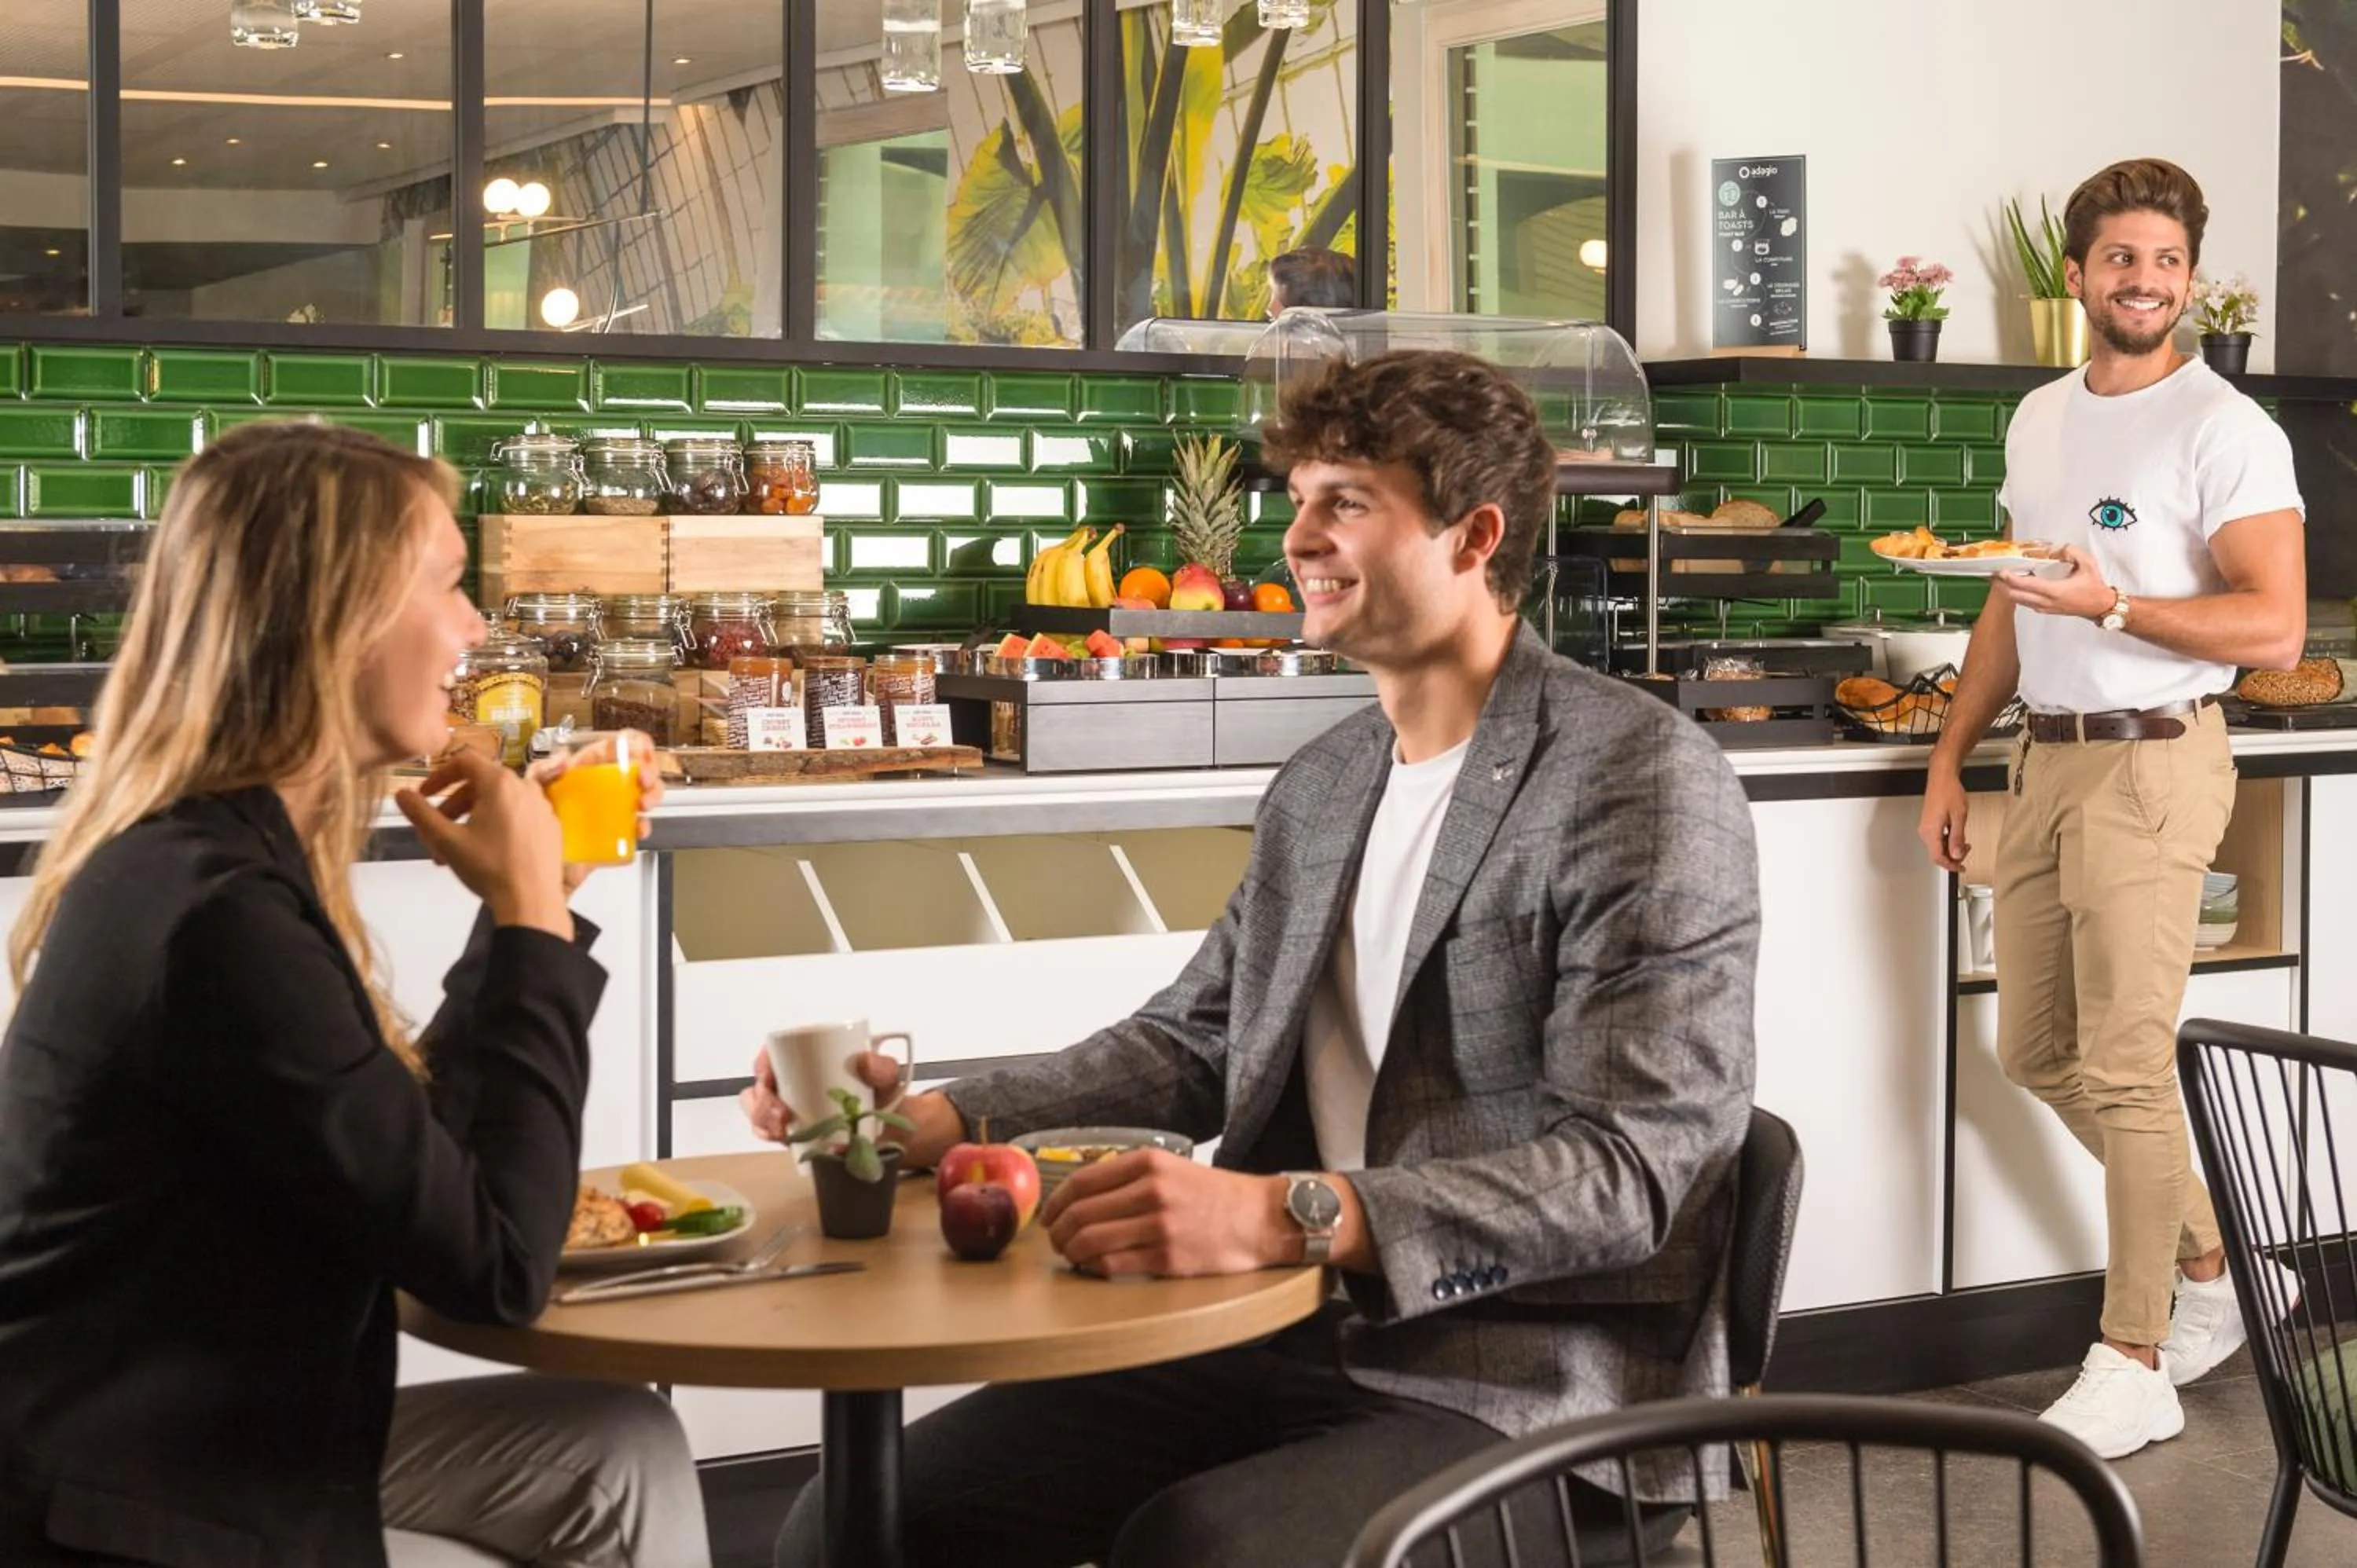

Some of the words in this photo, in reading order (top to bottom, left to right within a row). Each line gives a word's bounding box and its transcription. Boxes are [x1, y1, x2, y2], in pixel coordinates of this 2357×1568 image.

[1751, 165, 1778, 177] adagio
[1718, 210, 1737, 219] BAR
[1739, 207, 1746, 219] À
[1718, 220, 1754, 230] TOASTS
